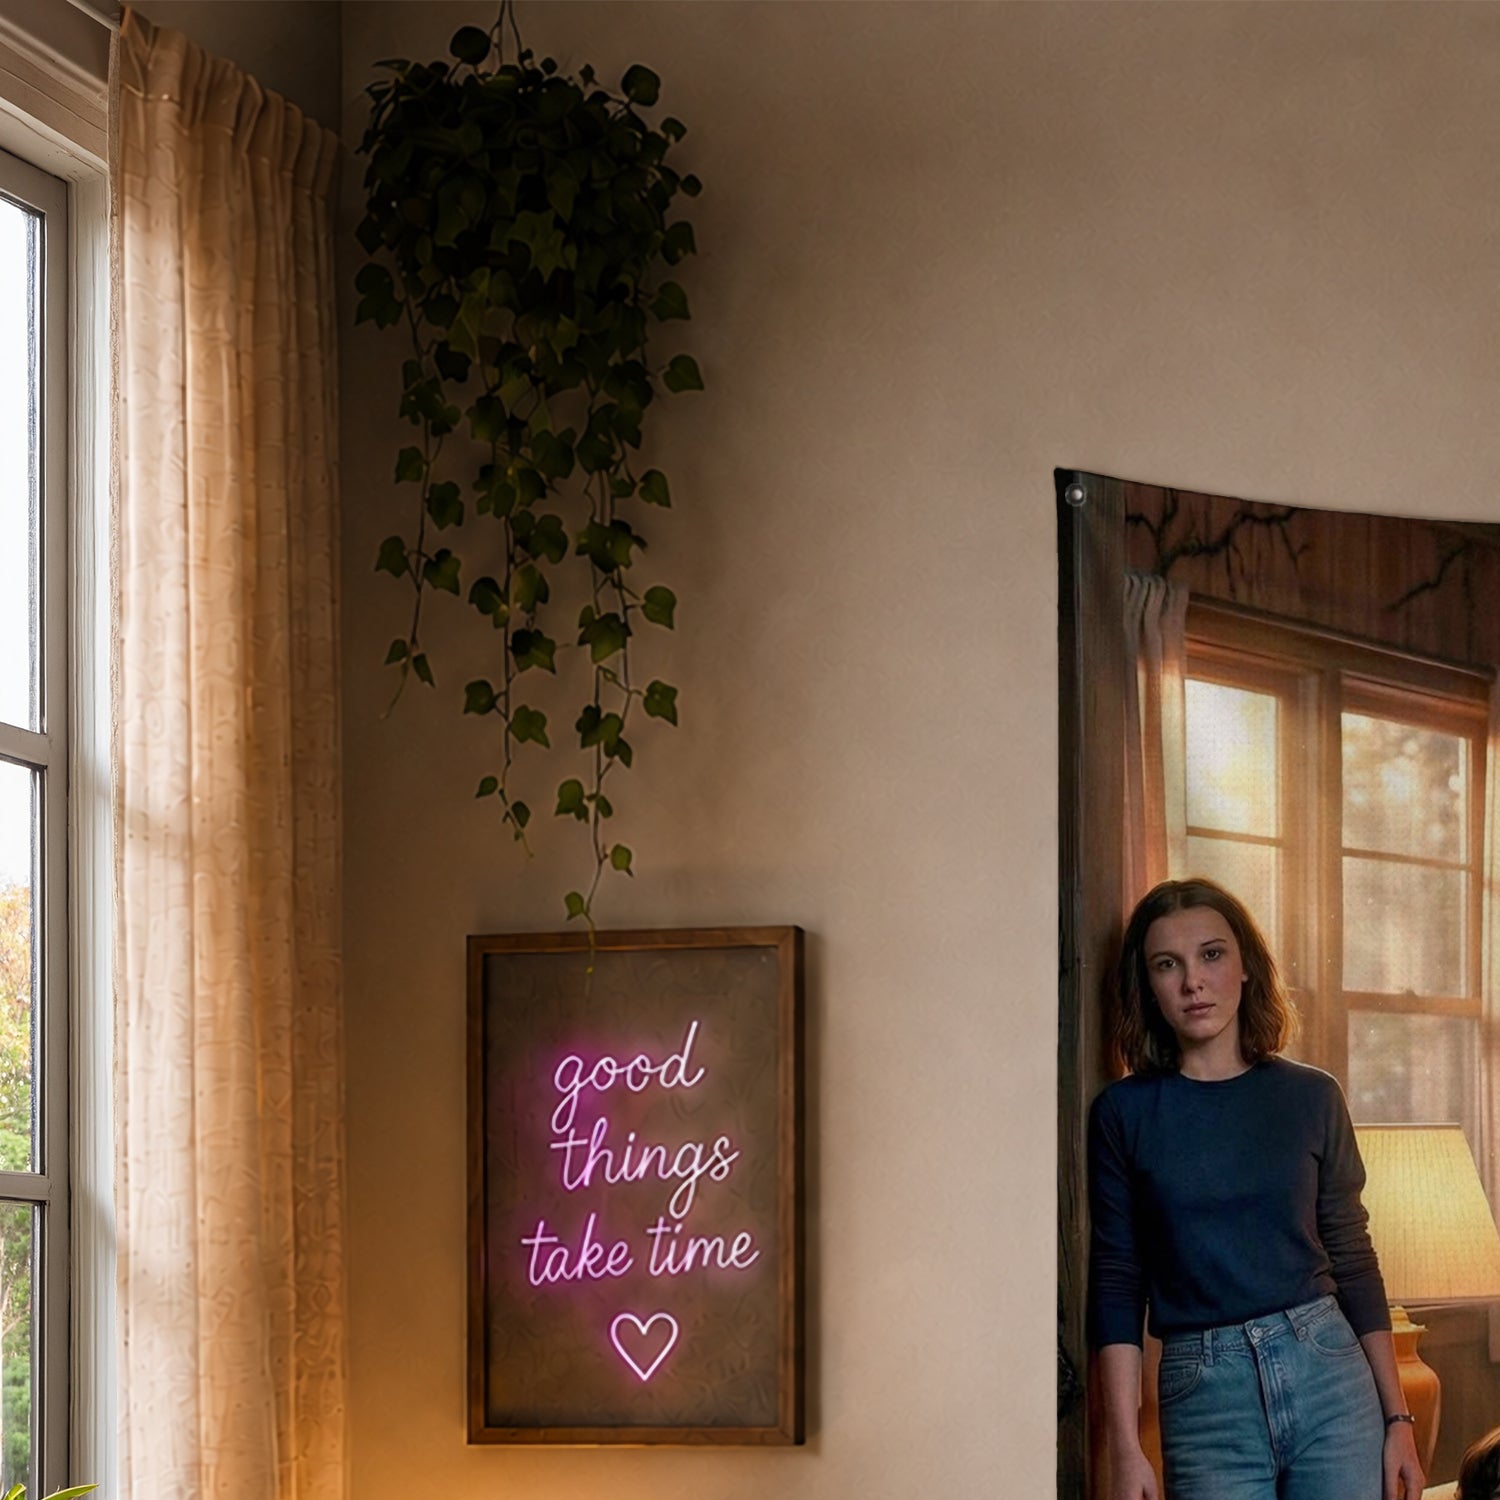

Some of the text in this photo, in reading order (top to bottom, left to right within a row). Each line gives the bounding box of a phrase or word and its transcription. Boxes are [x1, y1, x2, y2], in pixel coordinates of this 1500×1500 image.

[551, 1020, 705, 1134] good
[550, 1117, 740, 1220] things
[521, 1213, 760, 1287] take time
